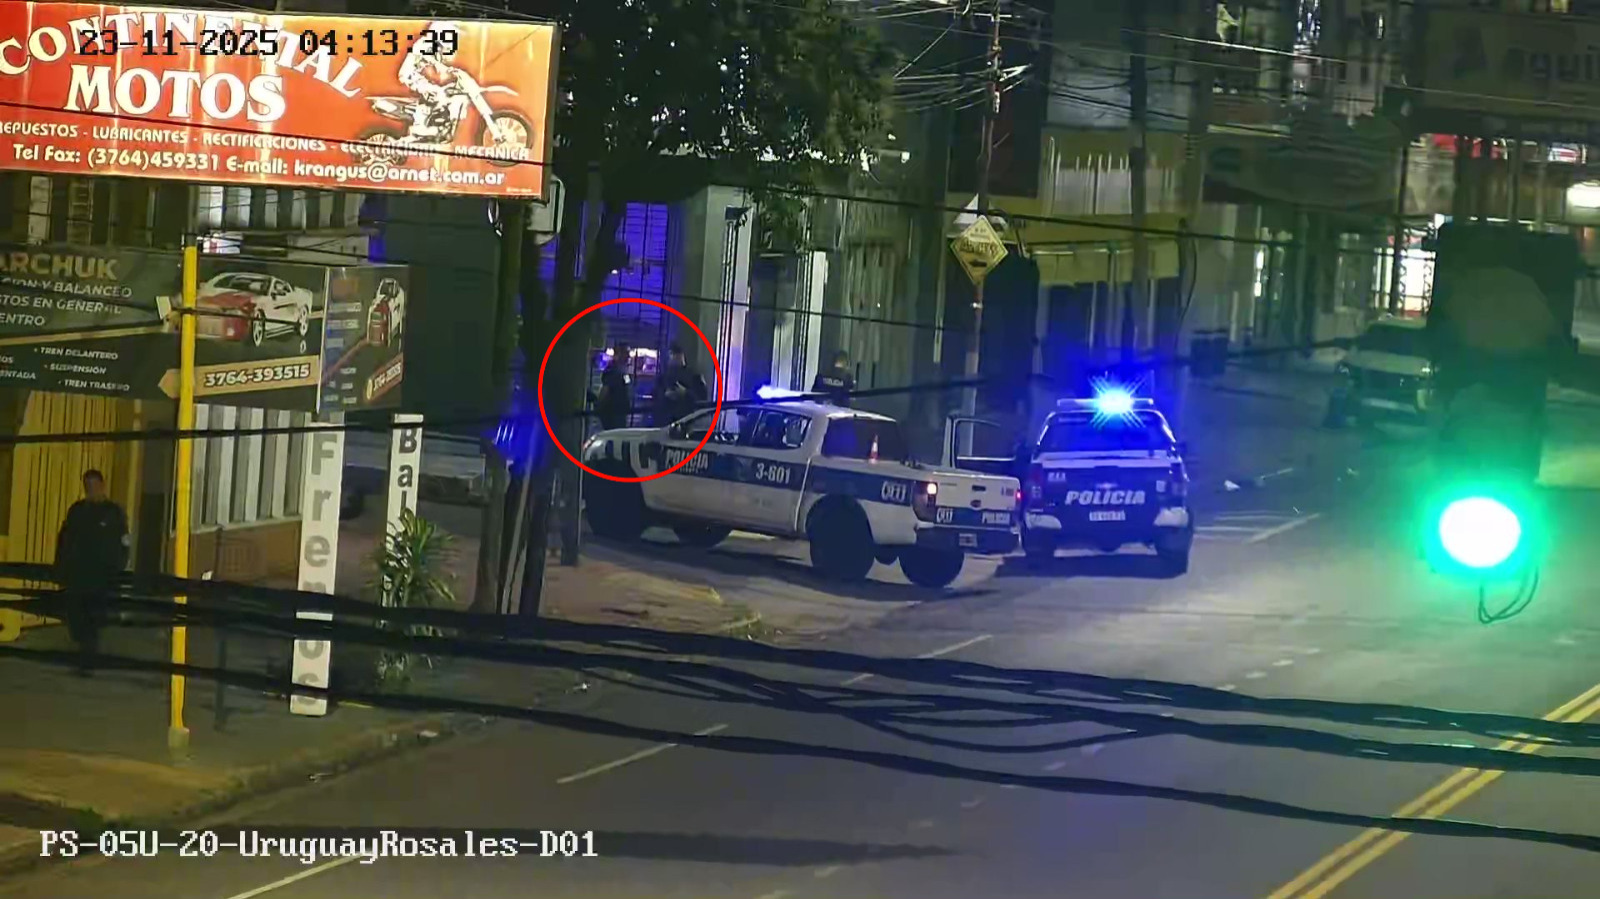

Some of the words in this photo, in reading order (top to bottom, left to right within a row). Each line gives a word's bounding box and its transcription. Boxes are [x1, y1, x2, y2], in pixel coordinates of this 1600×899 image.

[0, 11, 364, 98] CONTINENTAL
[63, 64, 287, 123] MOTOS
[93, 127, 188, 144] LUBRICANTES
[203, 132, 325, 152] RECTIFICACIONES
[13, 143, 39, 160] Tel
[45, 145, 80, 164] Fax:
[87, 147, 220, 171] (3764)459331
[226, 155, 287, 176] E-mail:
[294, 159, 505, 185] krangus@arnet.com.ar
[0, 294, 30, 307] TOS
[33, 296, 53, 308] EN
[54, 281, 133, 298] BALANCEO
[40, 346, 63, 357] TREN
[65, 348, 119, 361] DELANTERO
[64, 378, 87, 388] TREN
[204, 362, 311, 388] 3764-393515
